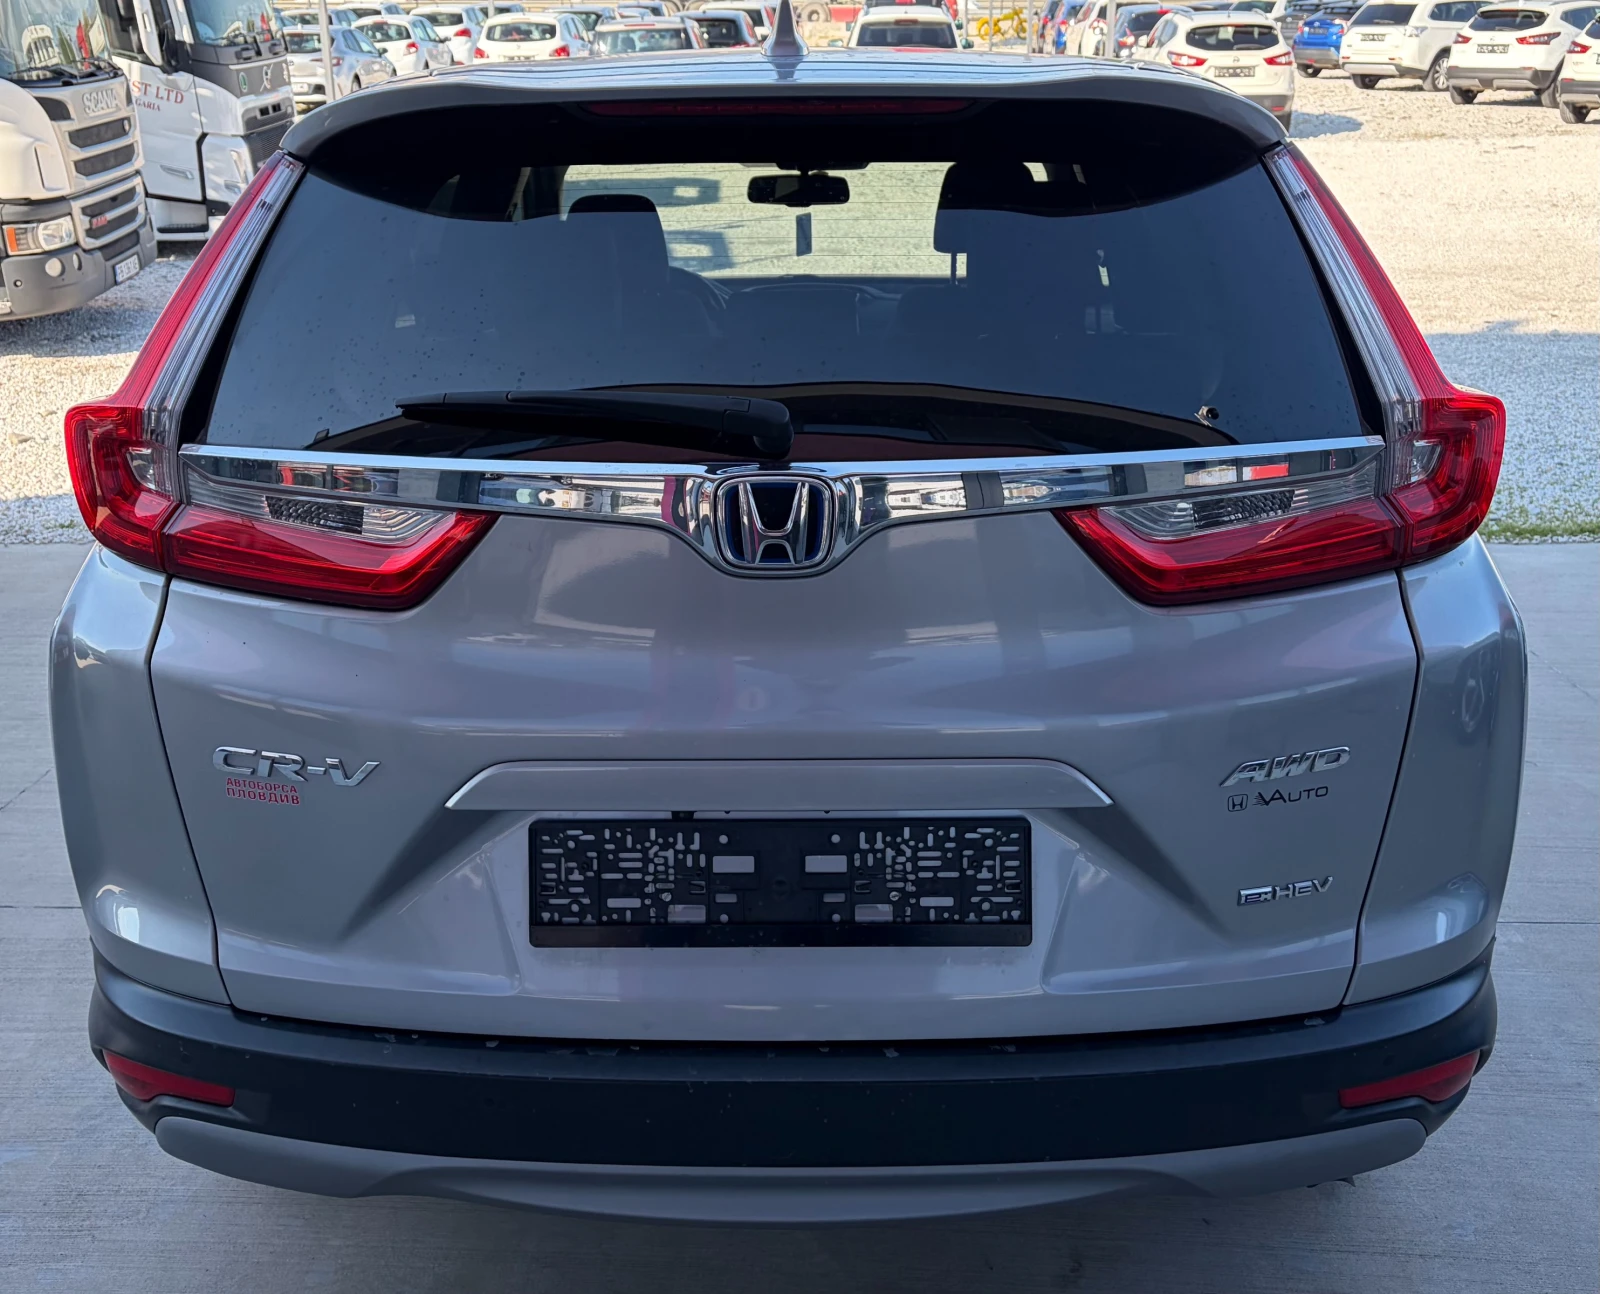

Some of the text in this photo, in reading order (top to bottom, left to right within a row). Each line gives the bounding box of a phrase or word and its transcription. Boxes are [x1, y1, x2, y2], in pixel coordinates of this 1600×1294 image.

[82, 88, 121, 114] SCANIA
[155, 86, 185, 104] LTD
[212, 746, 381, 786] CR-V
[1219, 746, 1350, 787] AWD
[226, 777, 298, 794] АВТОБОРСА
[226, 787, 300, 805] ПЛОВДИВ
